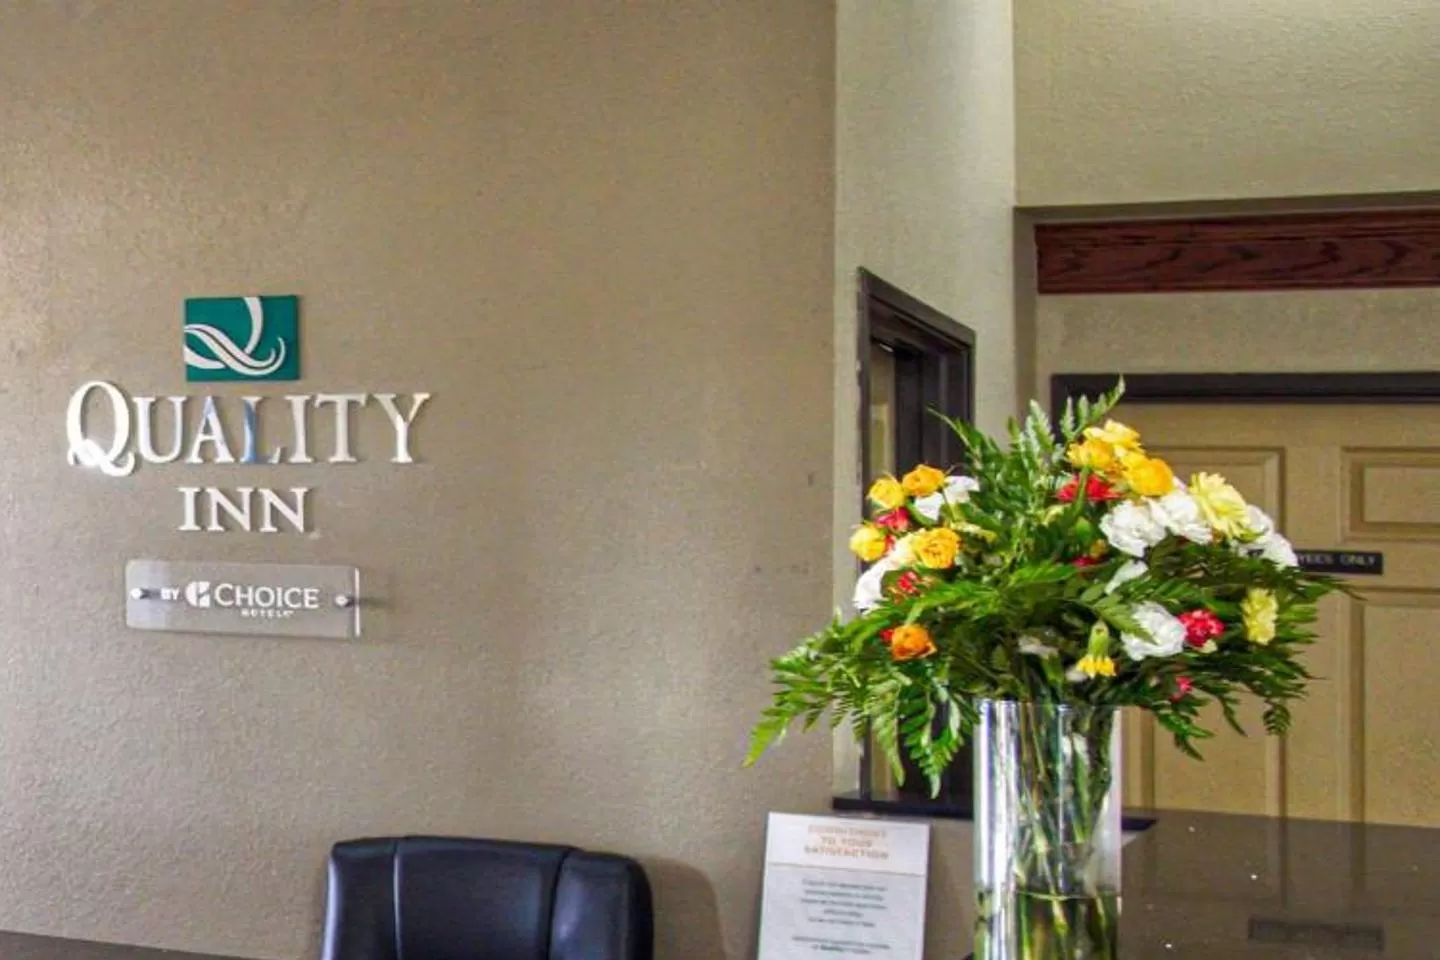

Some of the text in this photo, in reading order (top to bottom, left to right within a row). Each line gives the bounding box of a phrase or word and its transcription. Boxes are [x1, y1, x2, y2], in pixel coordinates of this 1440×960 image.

[66, 380, 431, 477] QUALITY
[176, 486, 309, 534] INN
[161, 582, 320, 609] BY CHOICE
